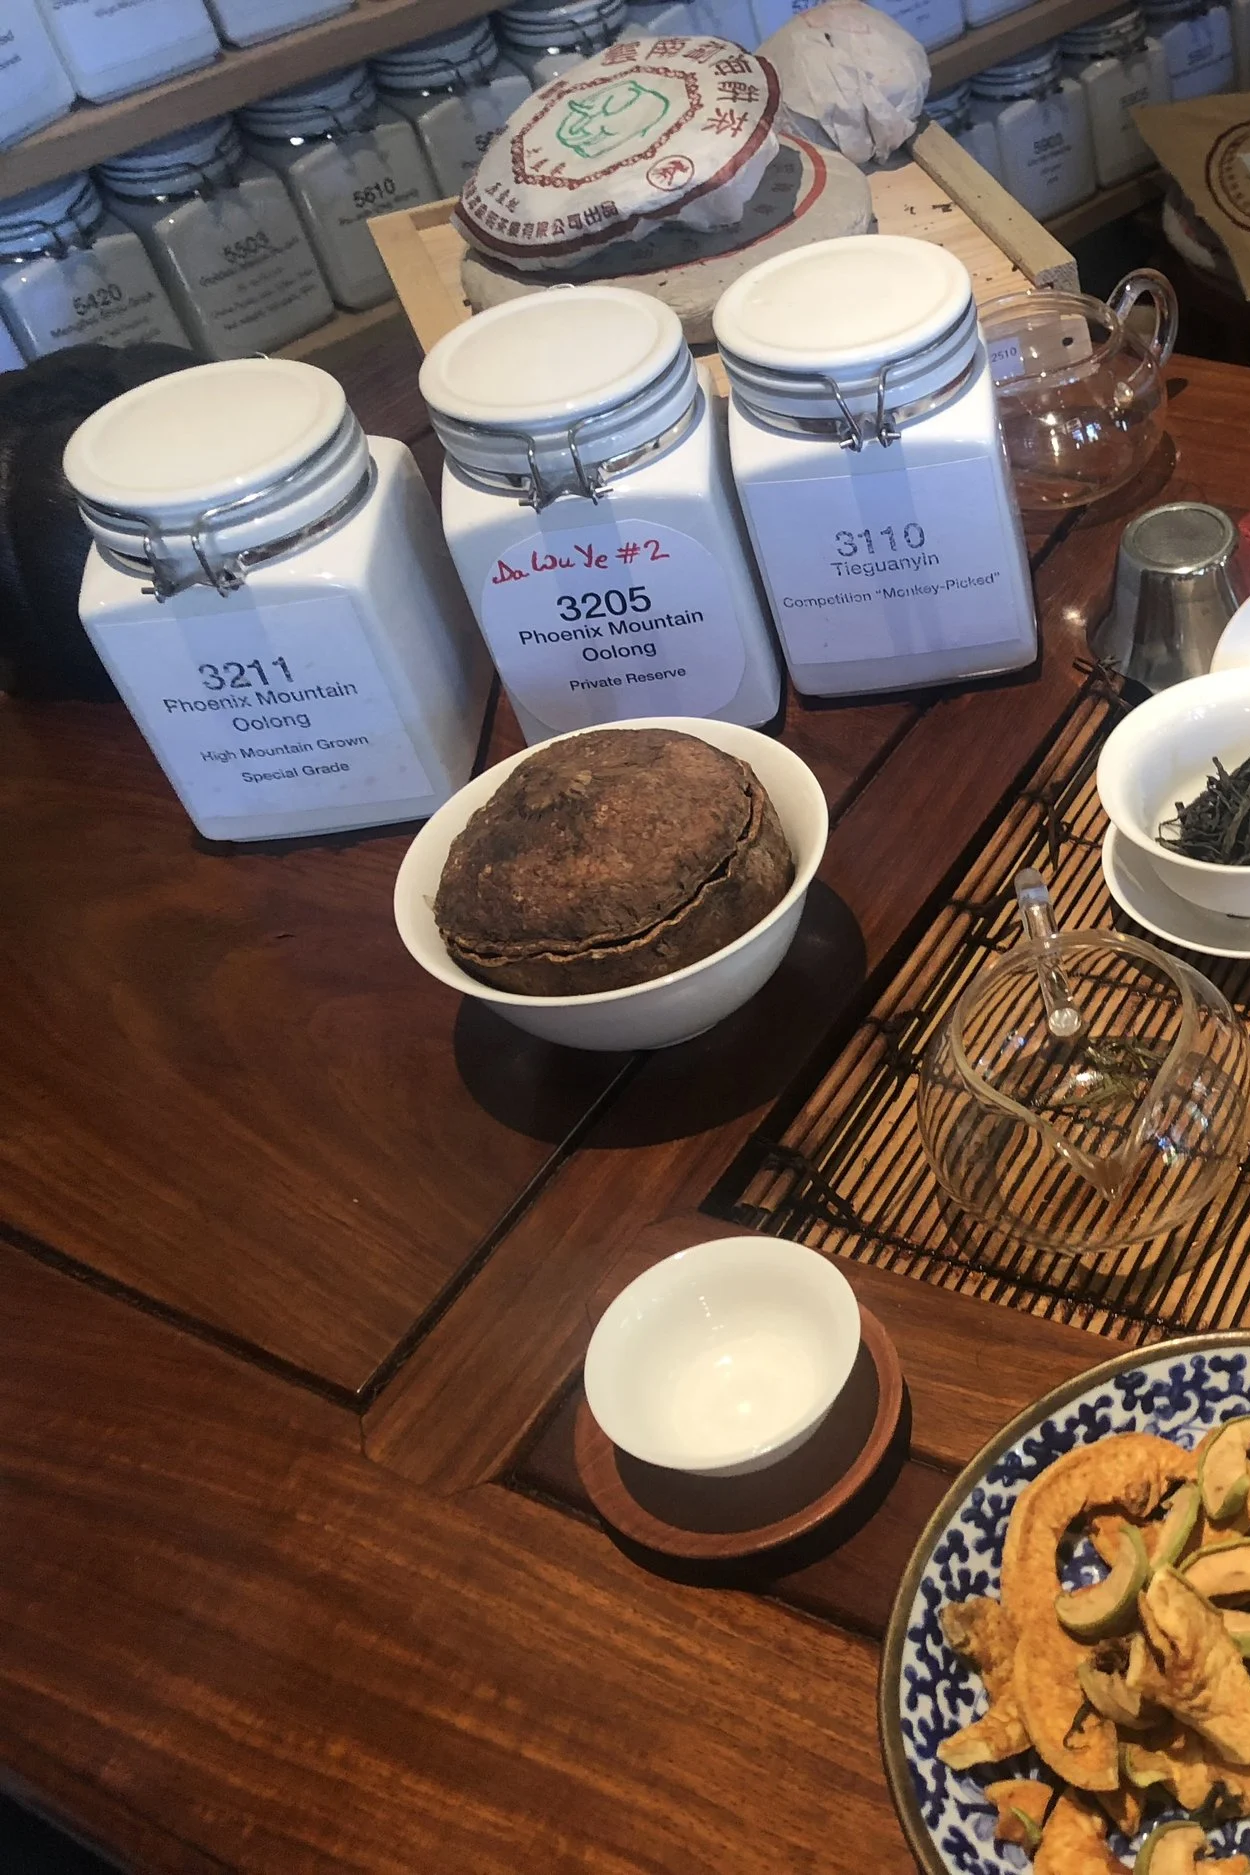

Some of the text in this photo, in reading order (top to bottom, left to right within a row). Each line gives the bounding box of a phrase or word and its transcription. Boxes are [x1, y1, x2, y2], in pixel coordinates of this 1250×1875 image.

[991, 347, 1017, 362] 2510
[835, 522, 926, 557] 3110
[492, 560, 530, 584] Da
[574, 543, 609, 569] Ye
[617, 539, 670, 565] #2
[830, 552, 940, 577] Tieguanyin
[556, 586, 652, 622] 3205
[783, 590, 872, 609] Competition
[519, 610, 704, 646] Phoenix Mountain
[582, 643, 657, 662] Oolong
[198, 656, 294, 691] 3211
[569, 667, 686, 691] Private Reserve
[163, 682, 358, 713] Phoenix Mountain
[232, 713, 311, 732] Oolong
[200, 735, 369, 764] High Mountain Grown
[241, 762, 350, 784] Special Grade
